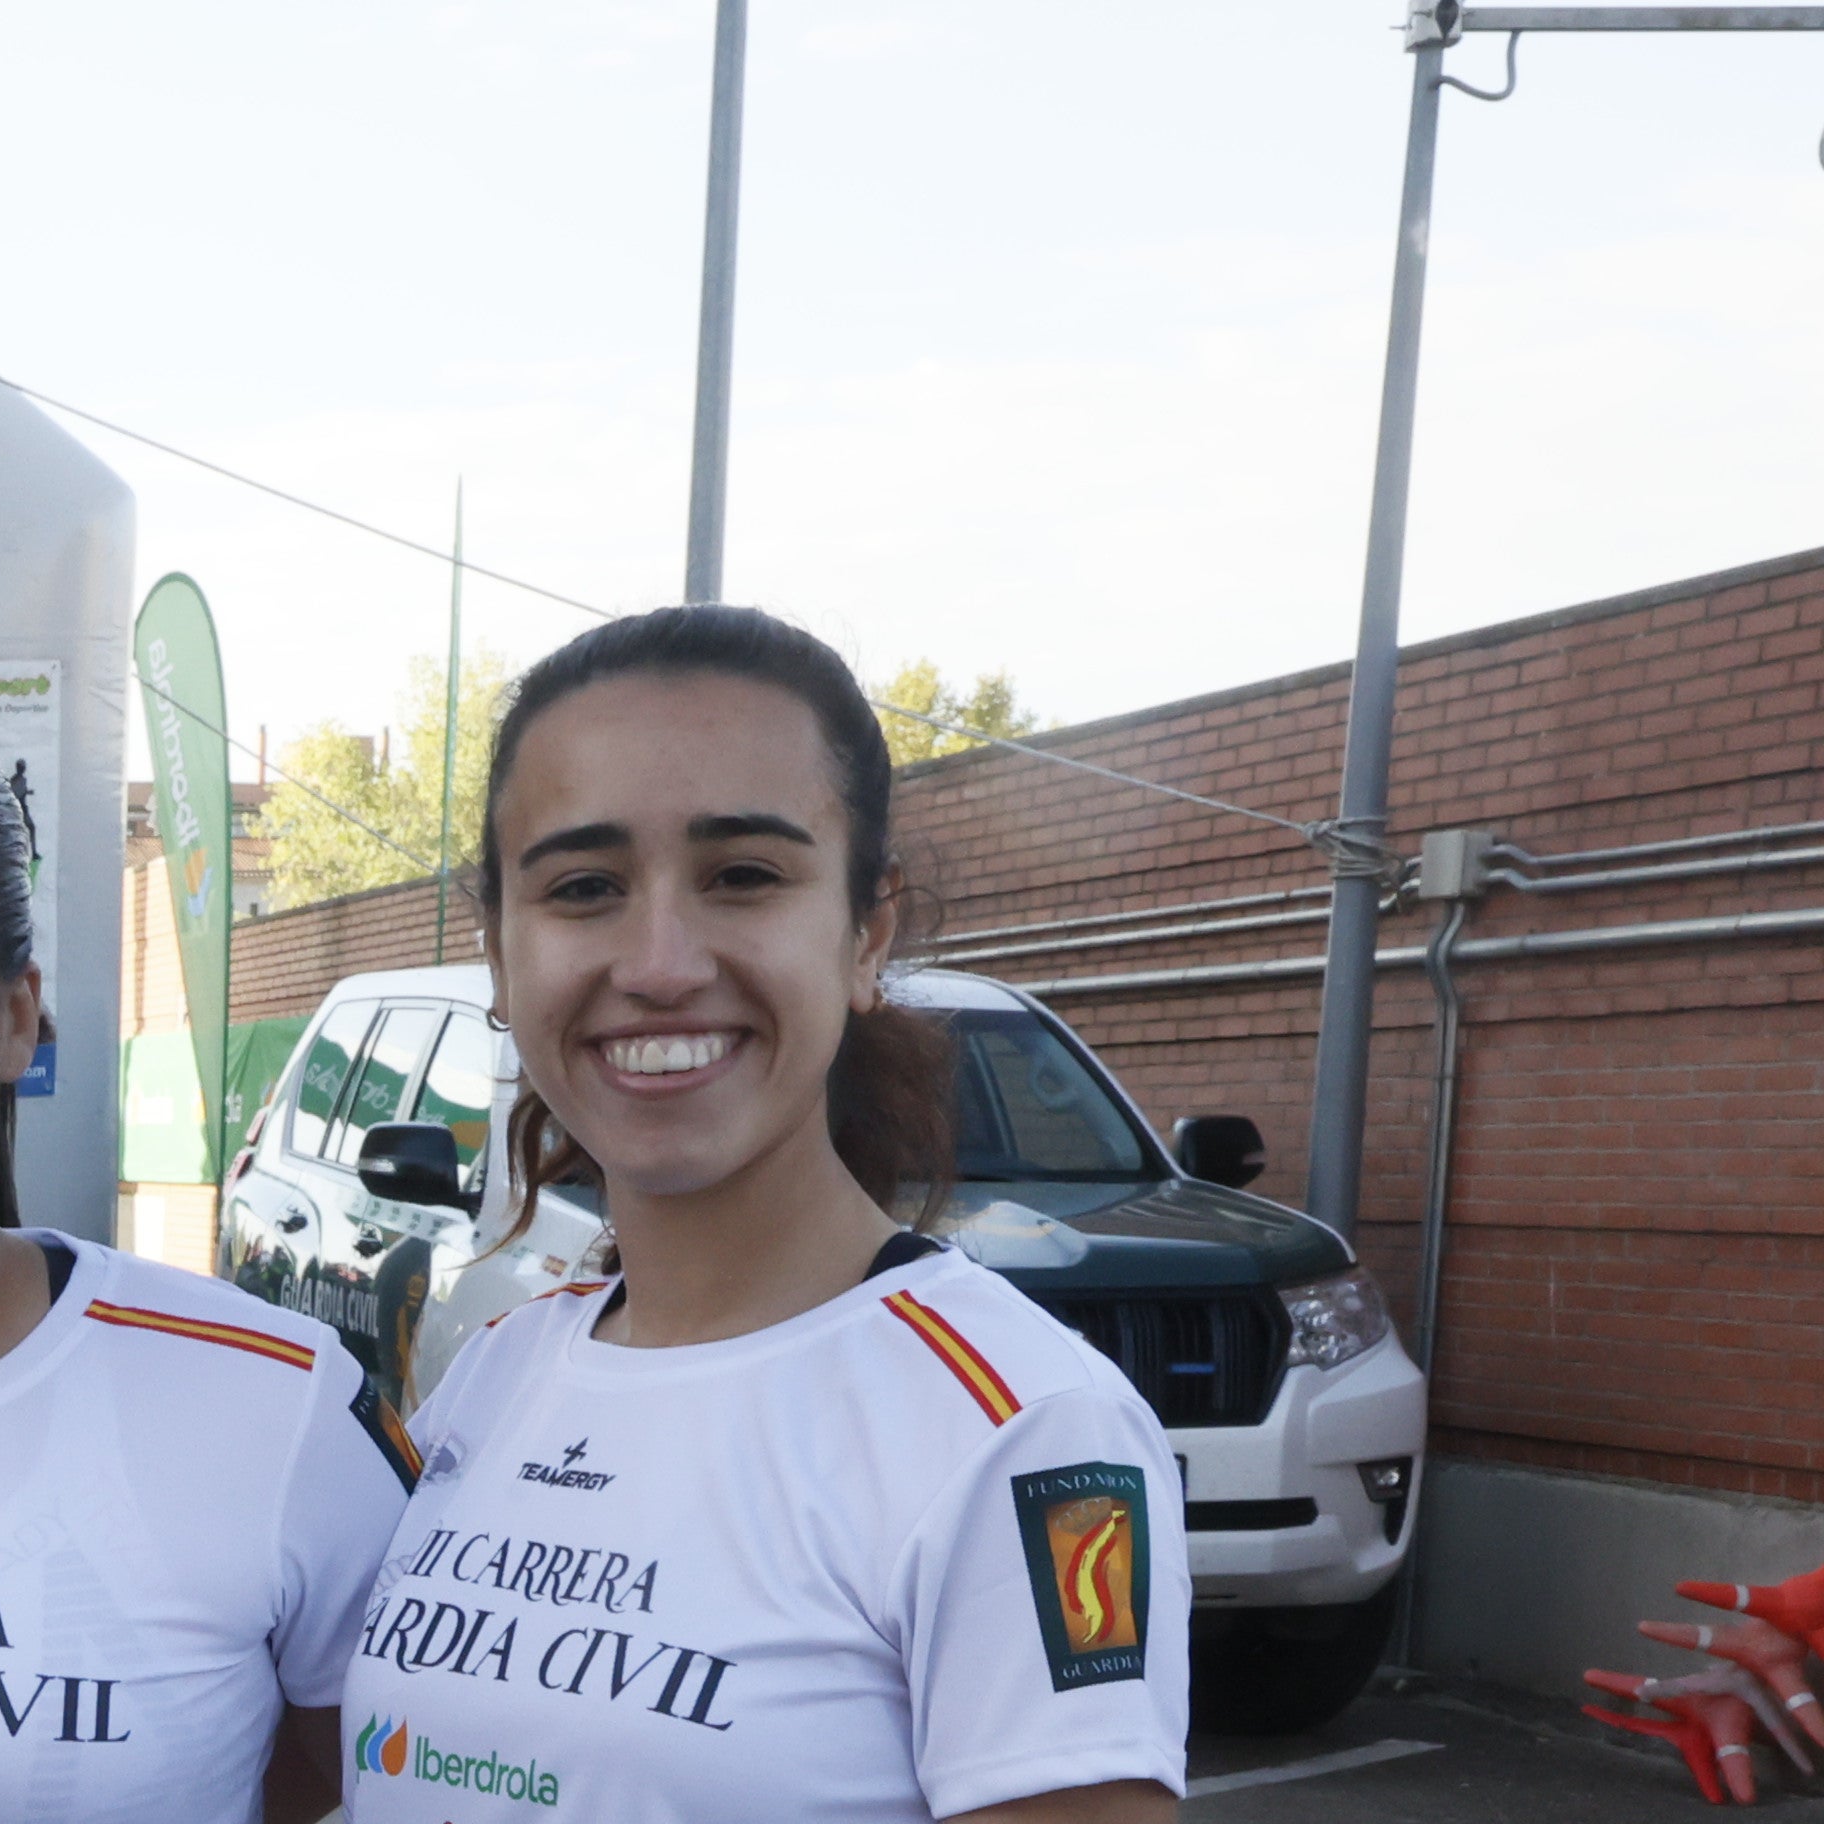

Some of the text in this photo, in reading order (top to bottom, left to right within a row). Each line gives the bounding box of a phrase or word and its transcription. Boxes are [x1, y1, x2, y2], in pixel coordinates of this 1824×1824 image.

[517, 1462, 617, 1493] TEAMERGY
[452, 1533, 660, 1614] CARRERA
[361, 1596, 739, 1732] ARDIA CIVIL
[414, 1734, 560, 1807] Iberdrola
